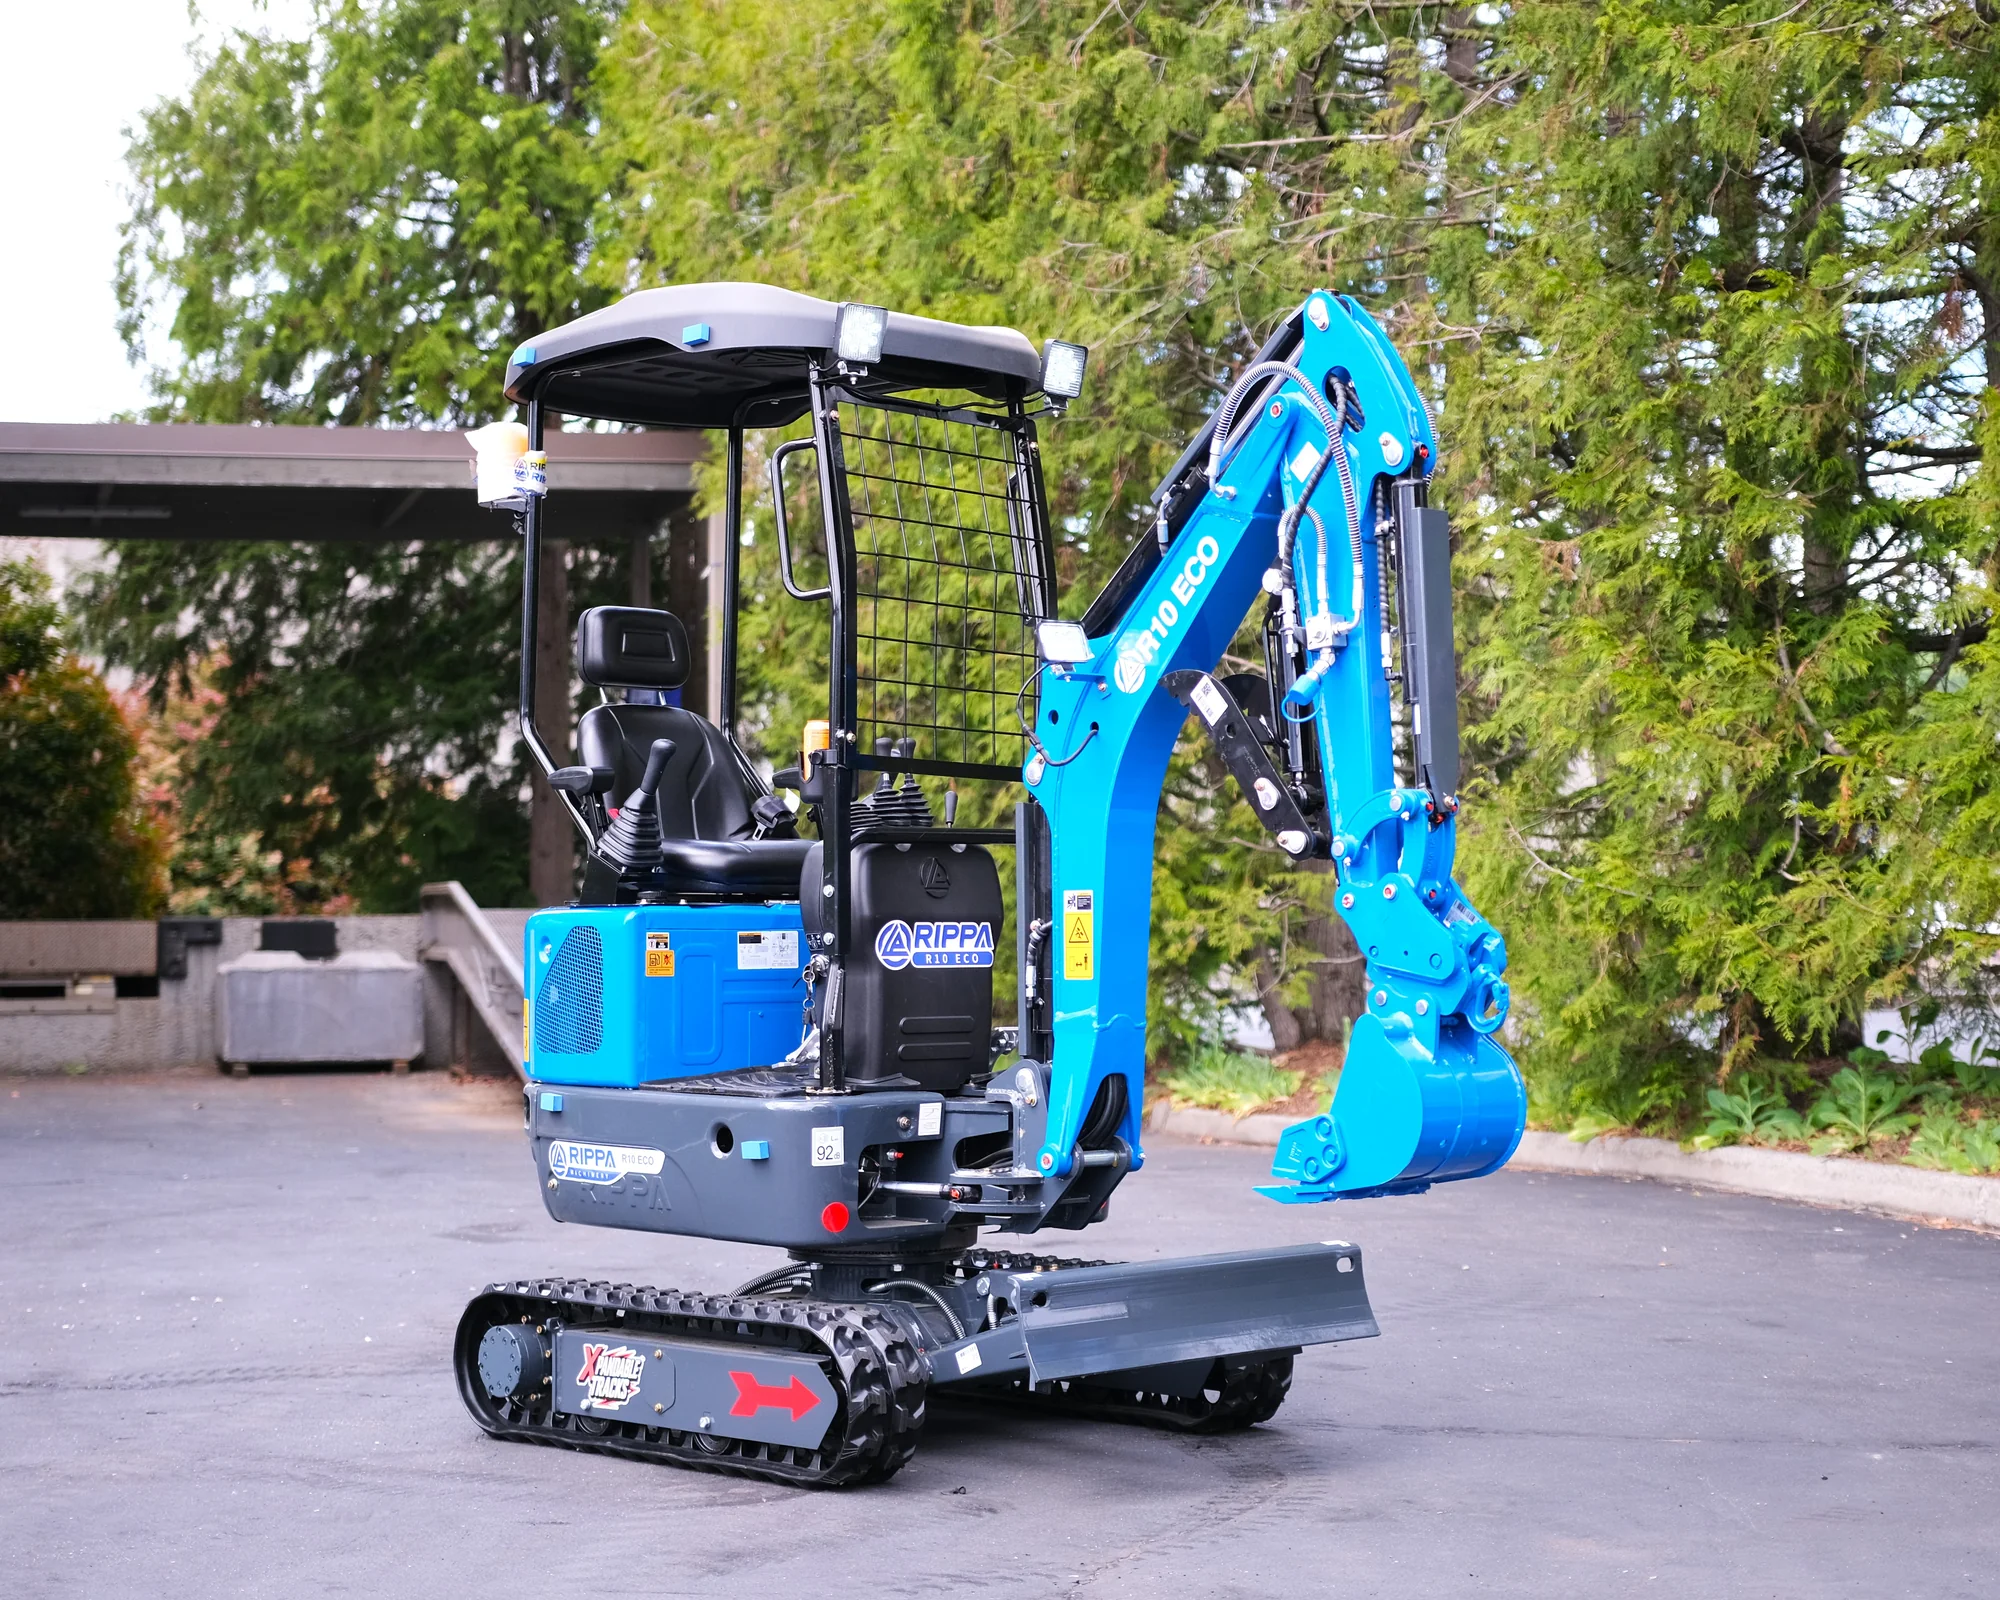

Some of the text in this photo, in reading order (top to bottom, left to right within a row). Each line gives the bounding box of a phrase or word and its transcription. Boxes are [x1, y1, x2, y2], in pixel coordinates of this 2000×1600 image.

[1135, 535, 1219, 662] R10 ECO
[914, 924, 993, 948] RIPPA
[925, 953, 979, 964] R10 ECO
[569, 1146, 655, 1168] RIPPA R10 ECO
[817, 1145, 834, 1160] 92
[590, 1376, 630, 1401] TRACKS
